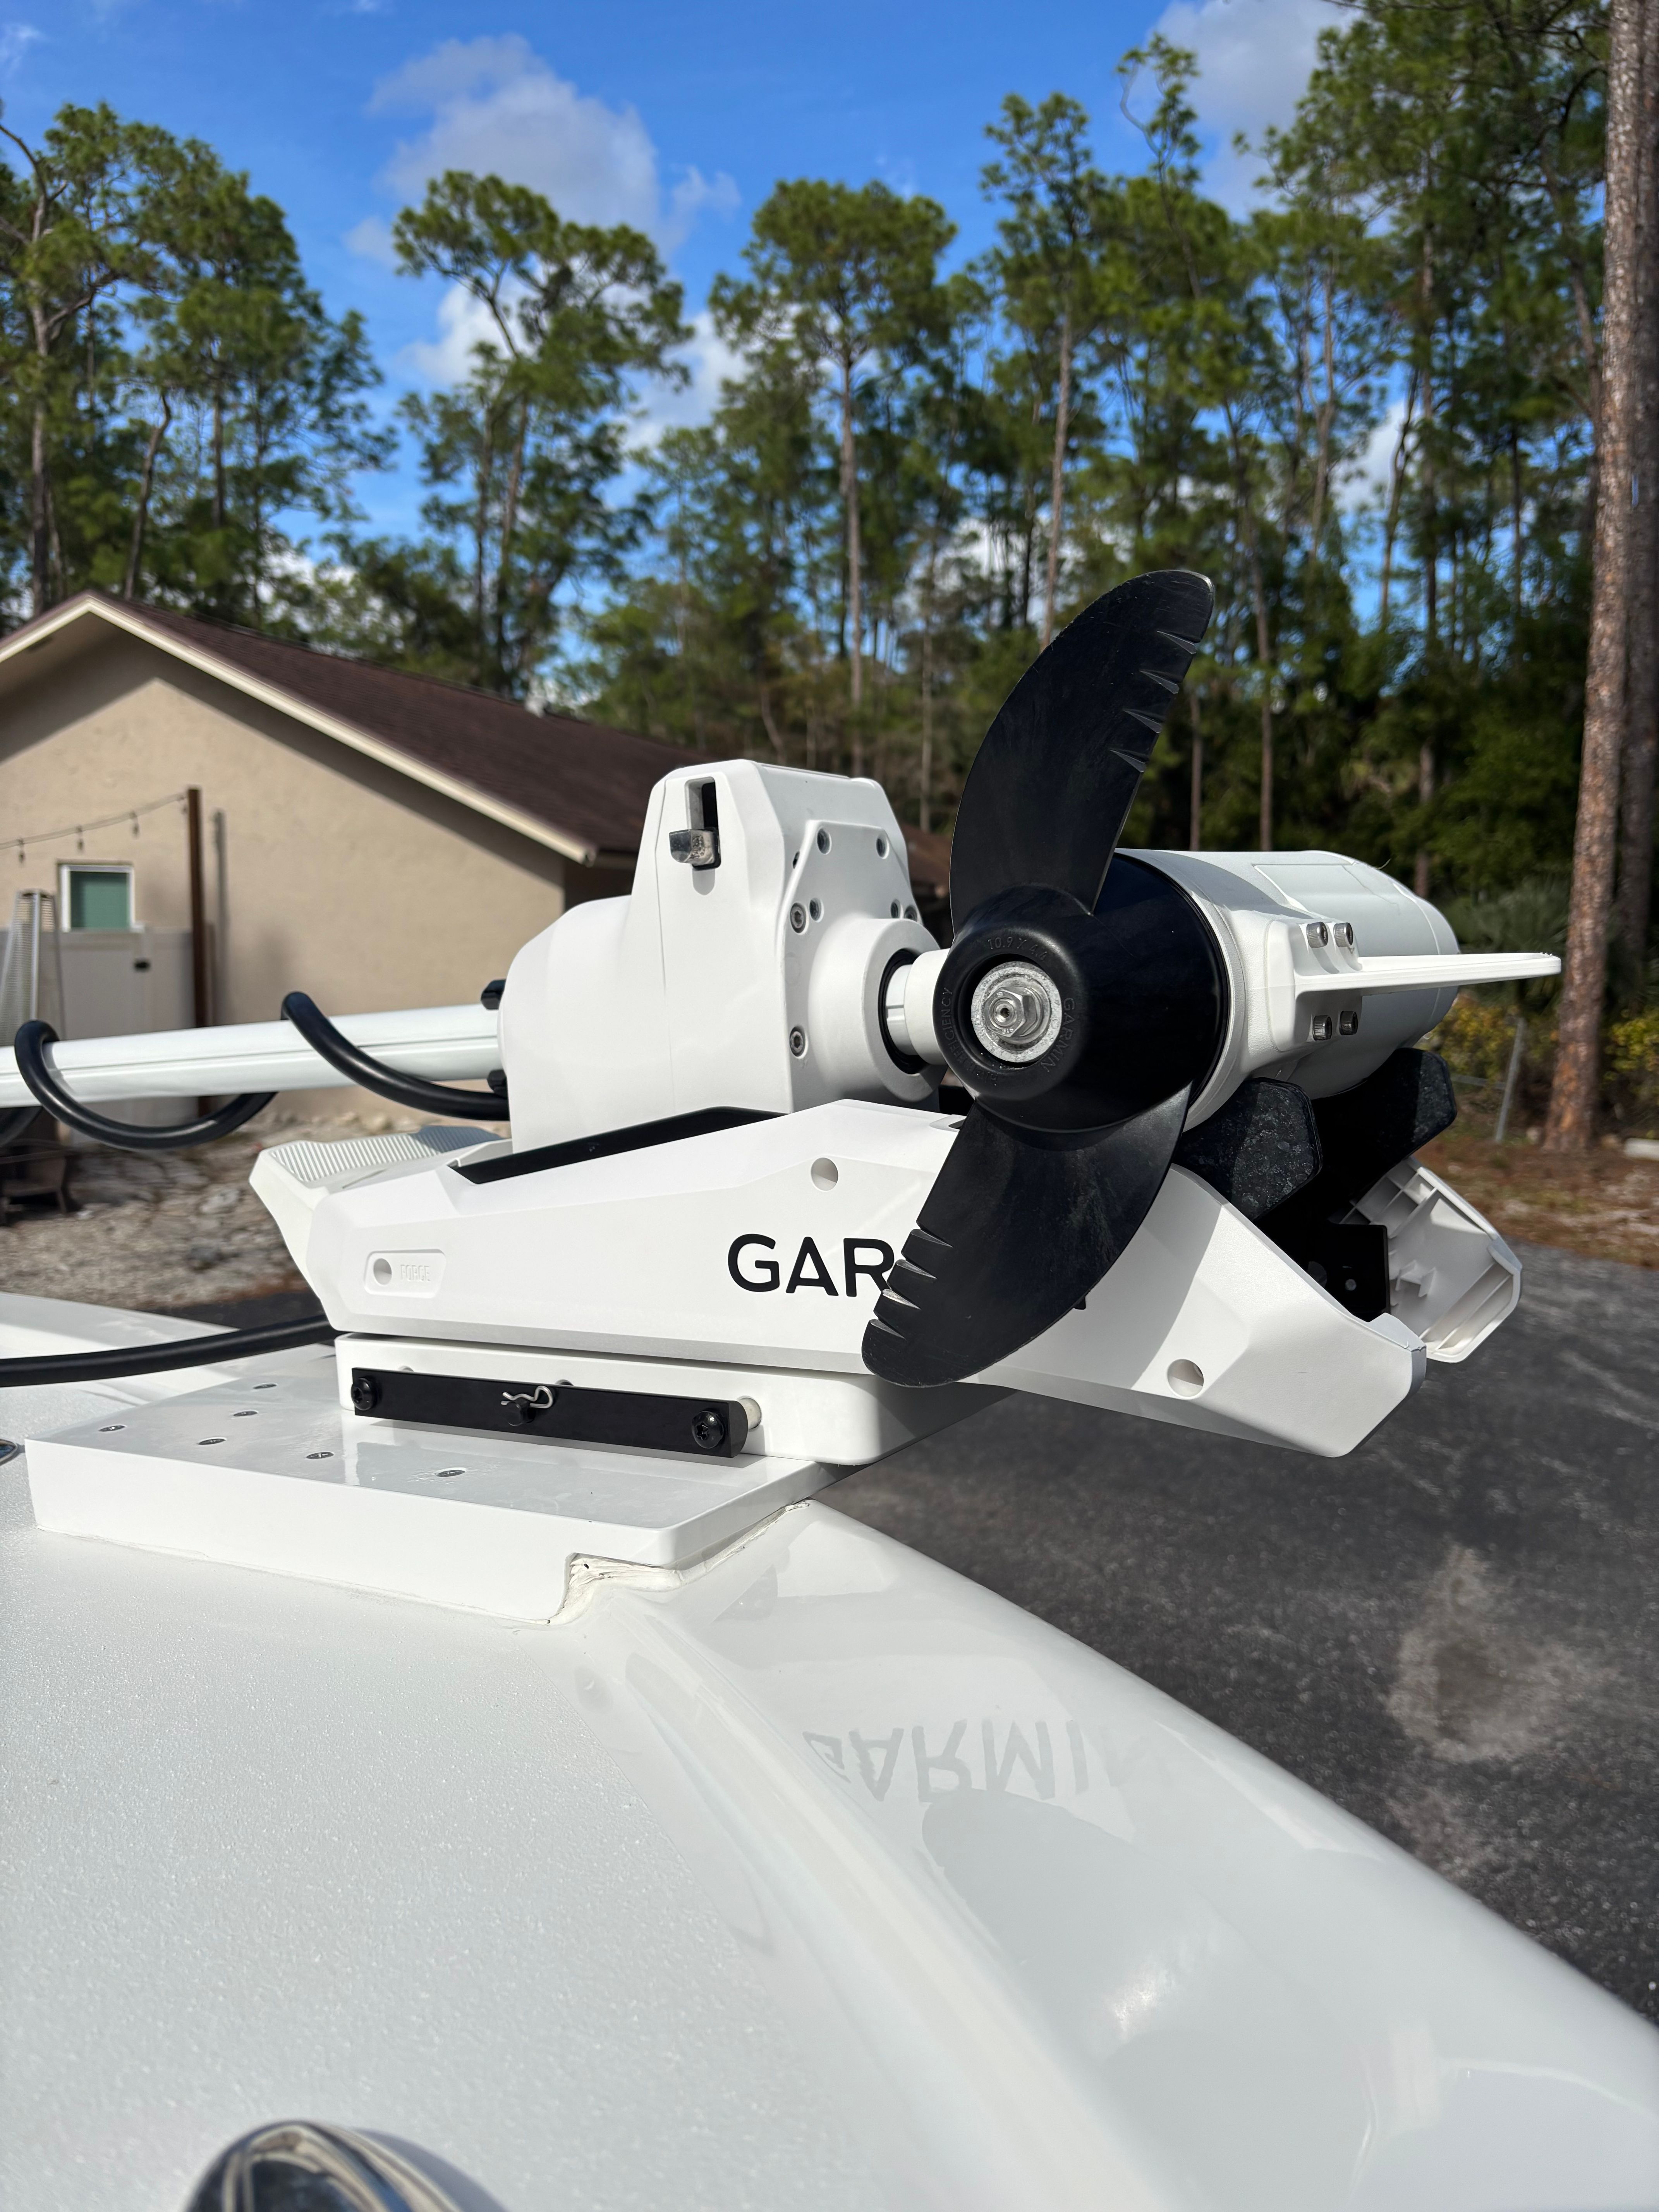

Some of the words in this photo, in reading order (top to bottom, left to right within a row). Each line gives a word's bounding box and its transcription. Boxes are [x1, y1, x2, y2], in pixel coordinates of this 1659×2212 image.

[988, 936, 1013, 950] 10.9
[1041, 997, 1075, 1072] GARMIN
[400, 1264, 431, 1282] FORCE
[728, 1233, 895, 1297] GAR
